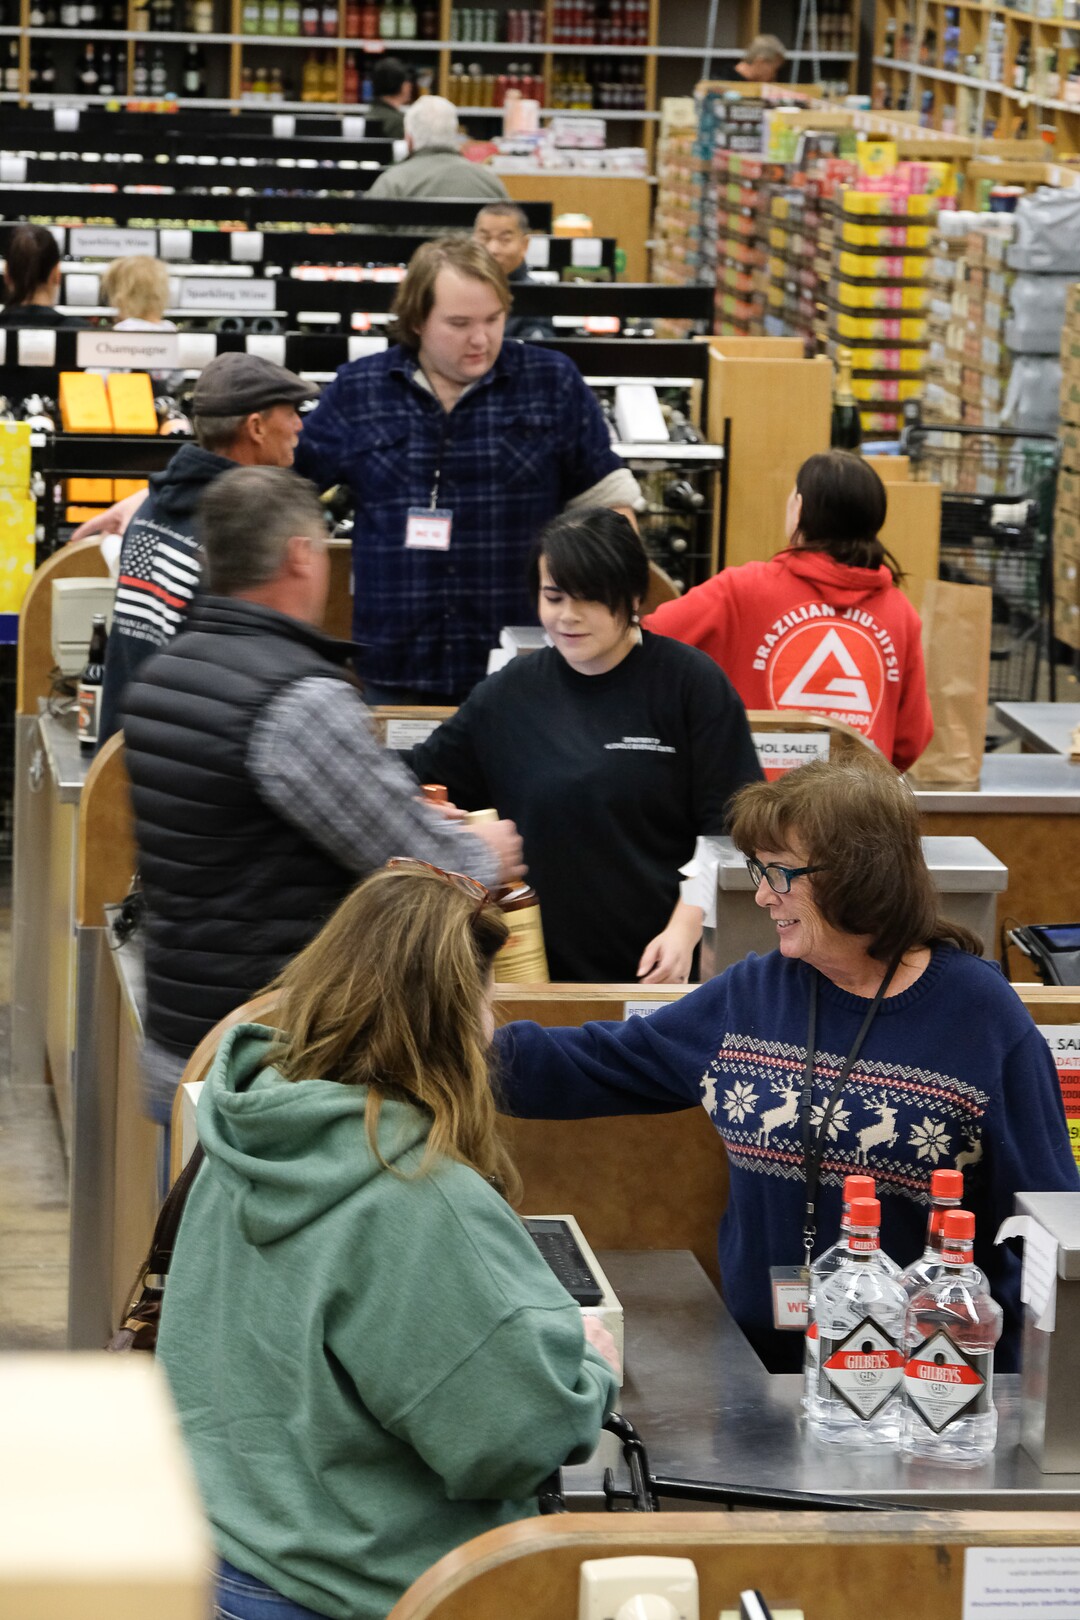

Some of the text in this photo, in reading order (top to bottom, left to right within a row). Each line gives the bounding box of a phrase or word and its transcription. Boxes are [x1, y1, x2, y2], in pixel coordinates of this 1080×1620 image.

[78, 236, 150, 248] Sparkling Wine
[186, 287, 267, 300] Sparkling Wine
[96, 342, 167, 357] Champagne
[752, 603, 900, 682] BRAZILIAN JIU-JITSU
[783, 744, 818, 754] SALES
[787, 1302, 808, 1313] WE
[844, 1353, 890, 1369] GILBEY'S
[860, 1371, 877, 1379] GIN
[917, 1365, 963, 1384] GILBEY'S
[931, 1383, 948, 1392] GIN
